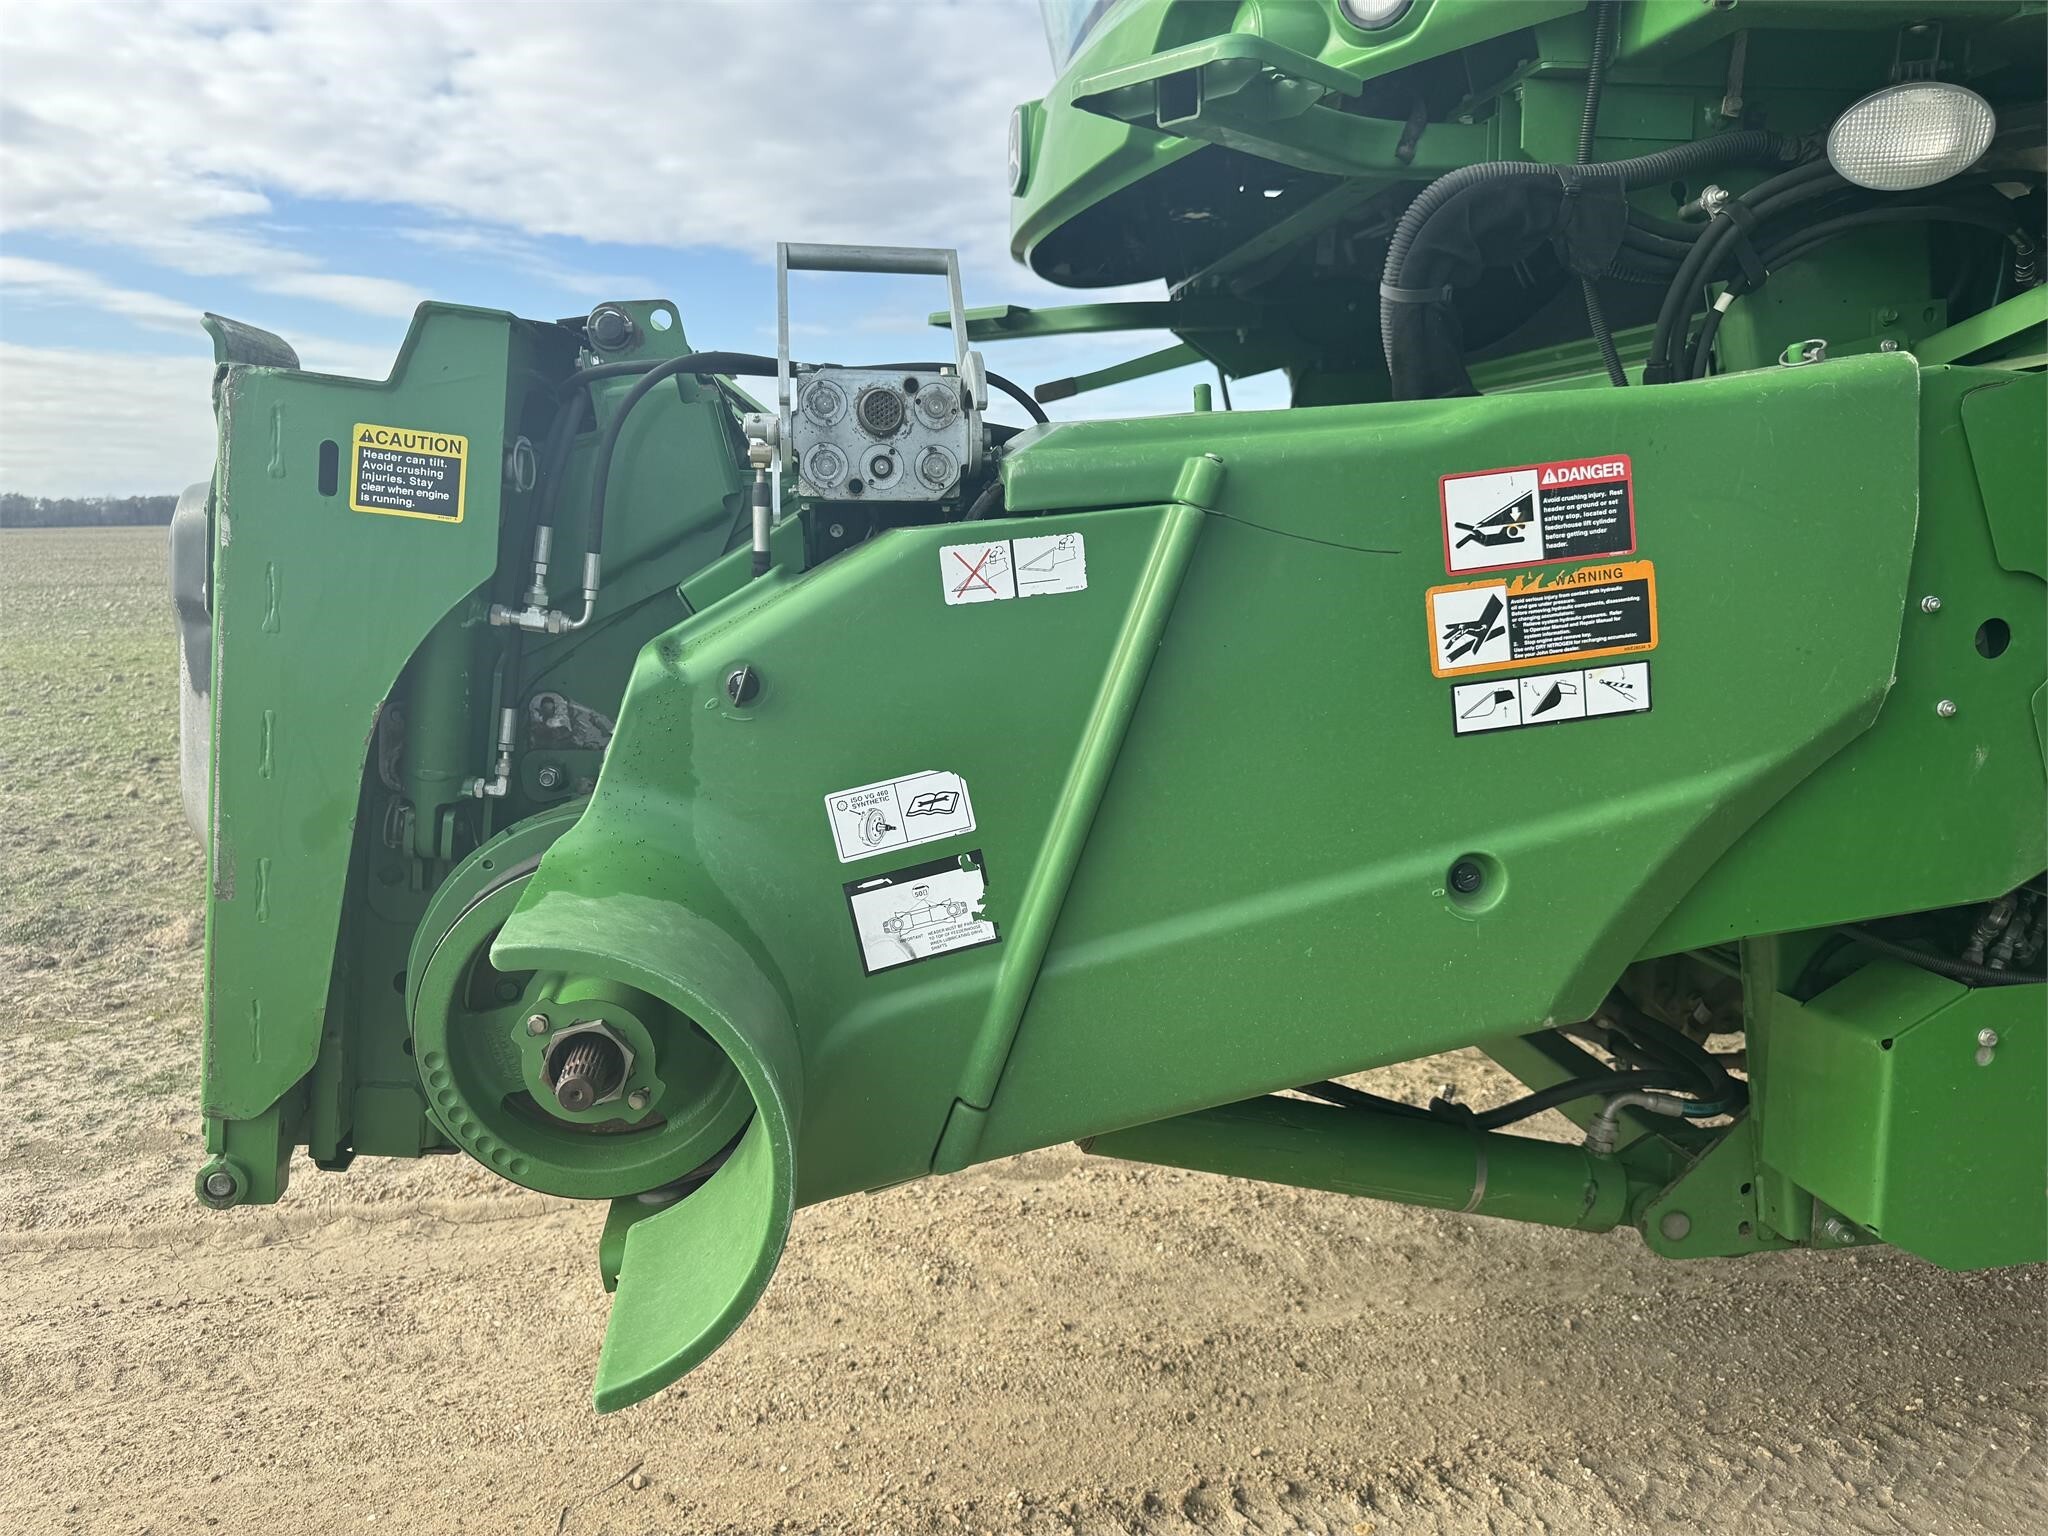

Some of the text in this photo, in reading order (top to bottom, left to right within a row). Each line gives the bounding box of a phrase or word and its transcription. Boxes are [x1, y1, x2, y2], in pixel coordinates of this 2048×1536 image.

[376, 430, 462, 454] CAUTION
[363, 449, 448, 468] Header can tilt.
[362, 461, 444, 480] Avoid crushing
[1558, 462, 1624, 482] DANGER
[362, 470, 434, 489] injuries. Stay
[361, 482, 450, 500] clear when engine
[1561, 494, 1588, 502] crushing
[1588, 491, 1607, 500] injury.
[360, 492, 416, 508] is running.
[1544, 504, 1565, 512] header
[1576, 501, 1598, 510] ground
[1544, 513, 1564, 522] safety
[1584, 508, 1607, 517] located
[1544, 521, 1582, 531] feederhouse
[1592, 517, 1617, 526] cylinder
[1566, 529, 1588, 538] getting
[1546, 541, 1568, 549] header.
[1556, 568, 1623, 586] WARNING
[850, 795, 863, 803] ISO
[851, 795, 890, 810] SYNTHETIC
